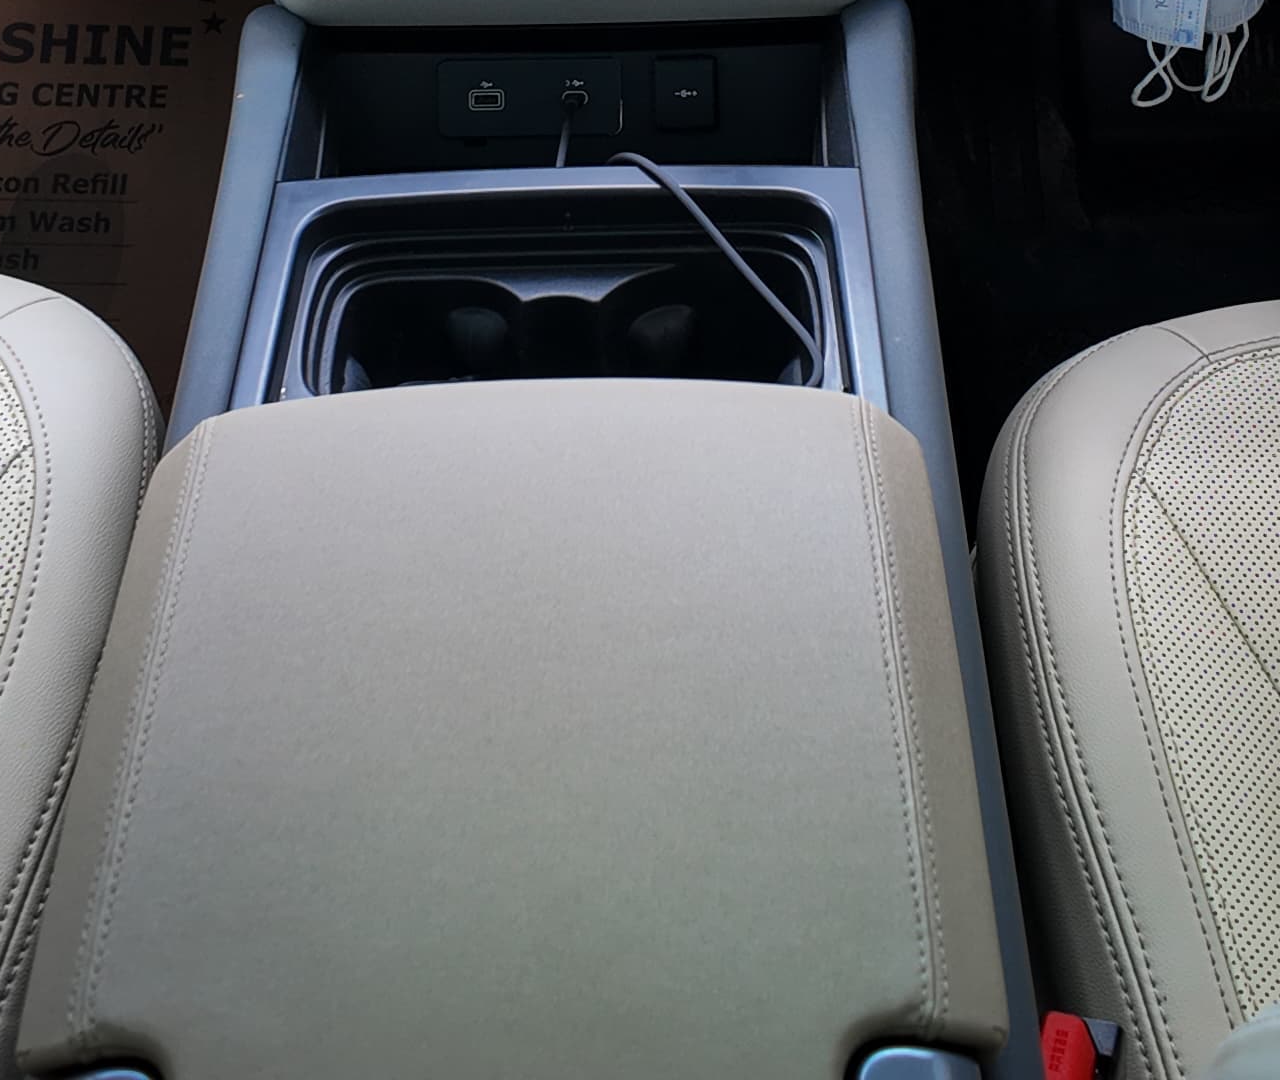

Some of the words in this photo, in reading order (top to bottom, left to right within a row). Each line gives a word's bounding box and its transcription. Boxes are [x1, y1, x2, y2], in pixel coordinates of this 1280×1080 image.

[0, 23, 192, 66] SHINE
[32, 82, 168, 108] CENTRE
[52, 172, 128, 196] Refill
[29, 210, 110, 235] Wash
